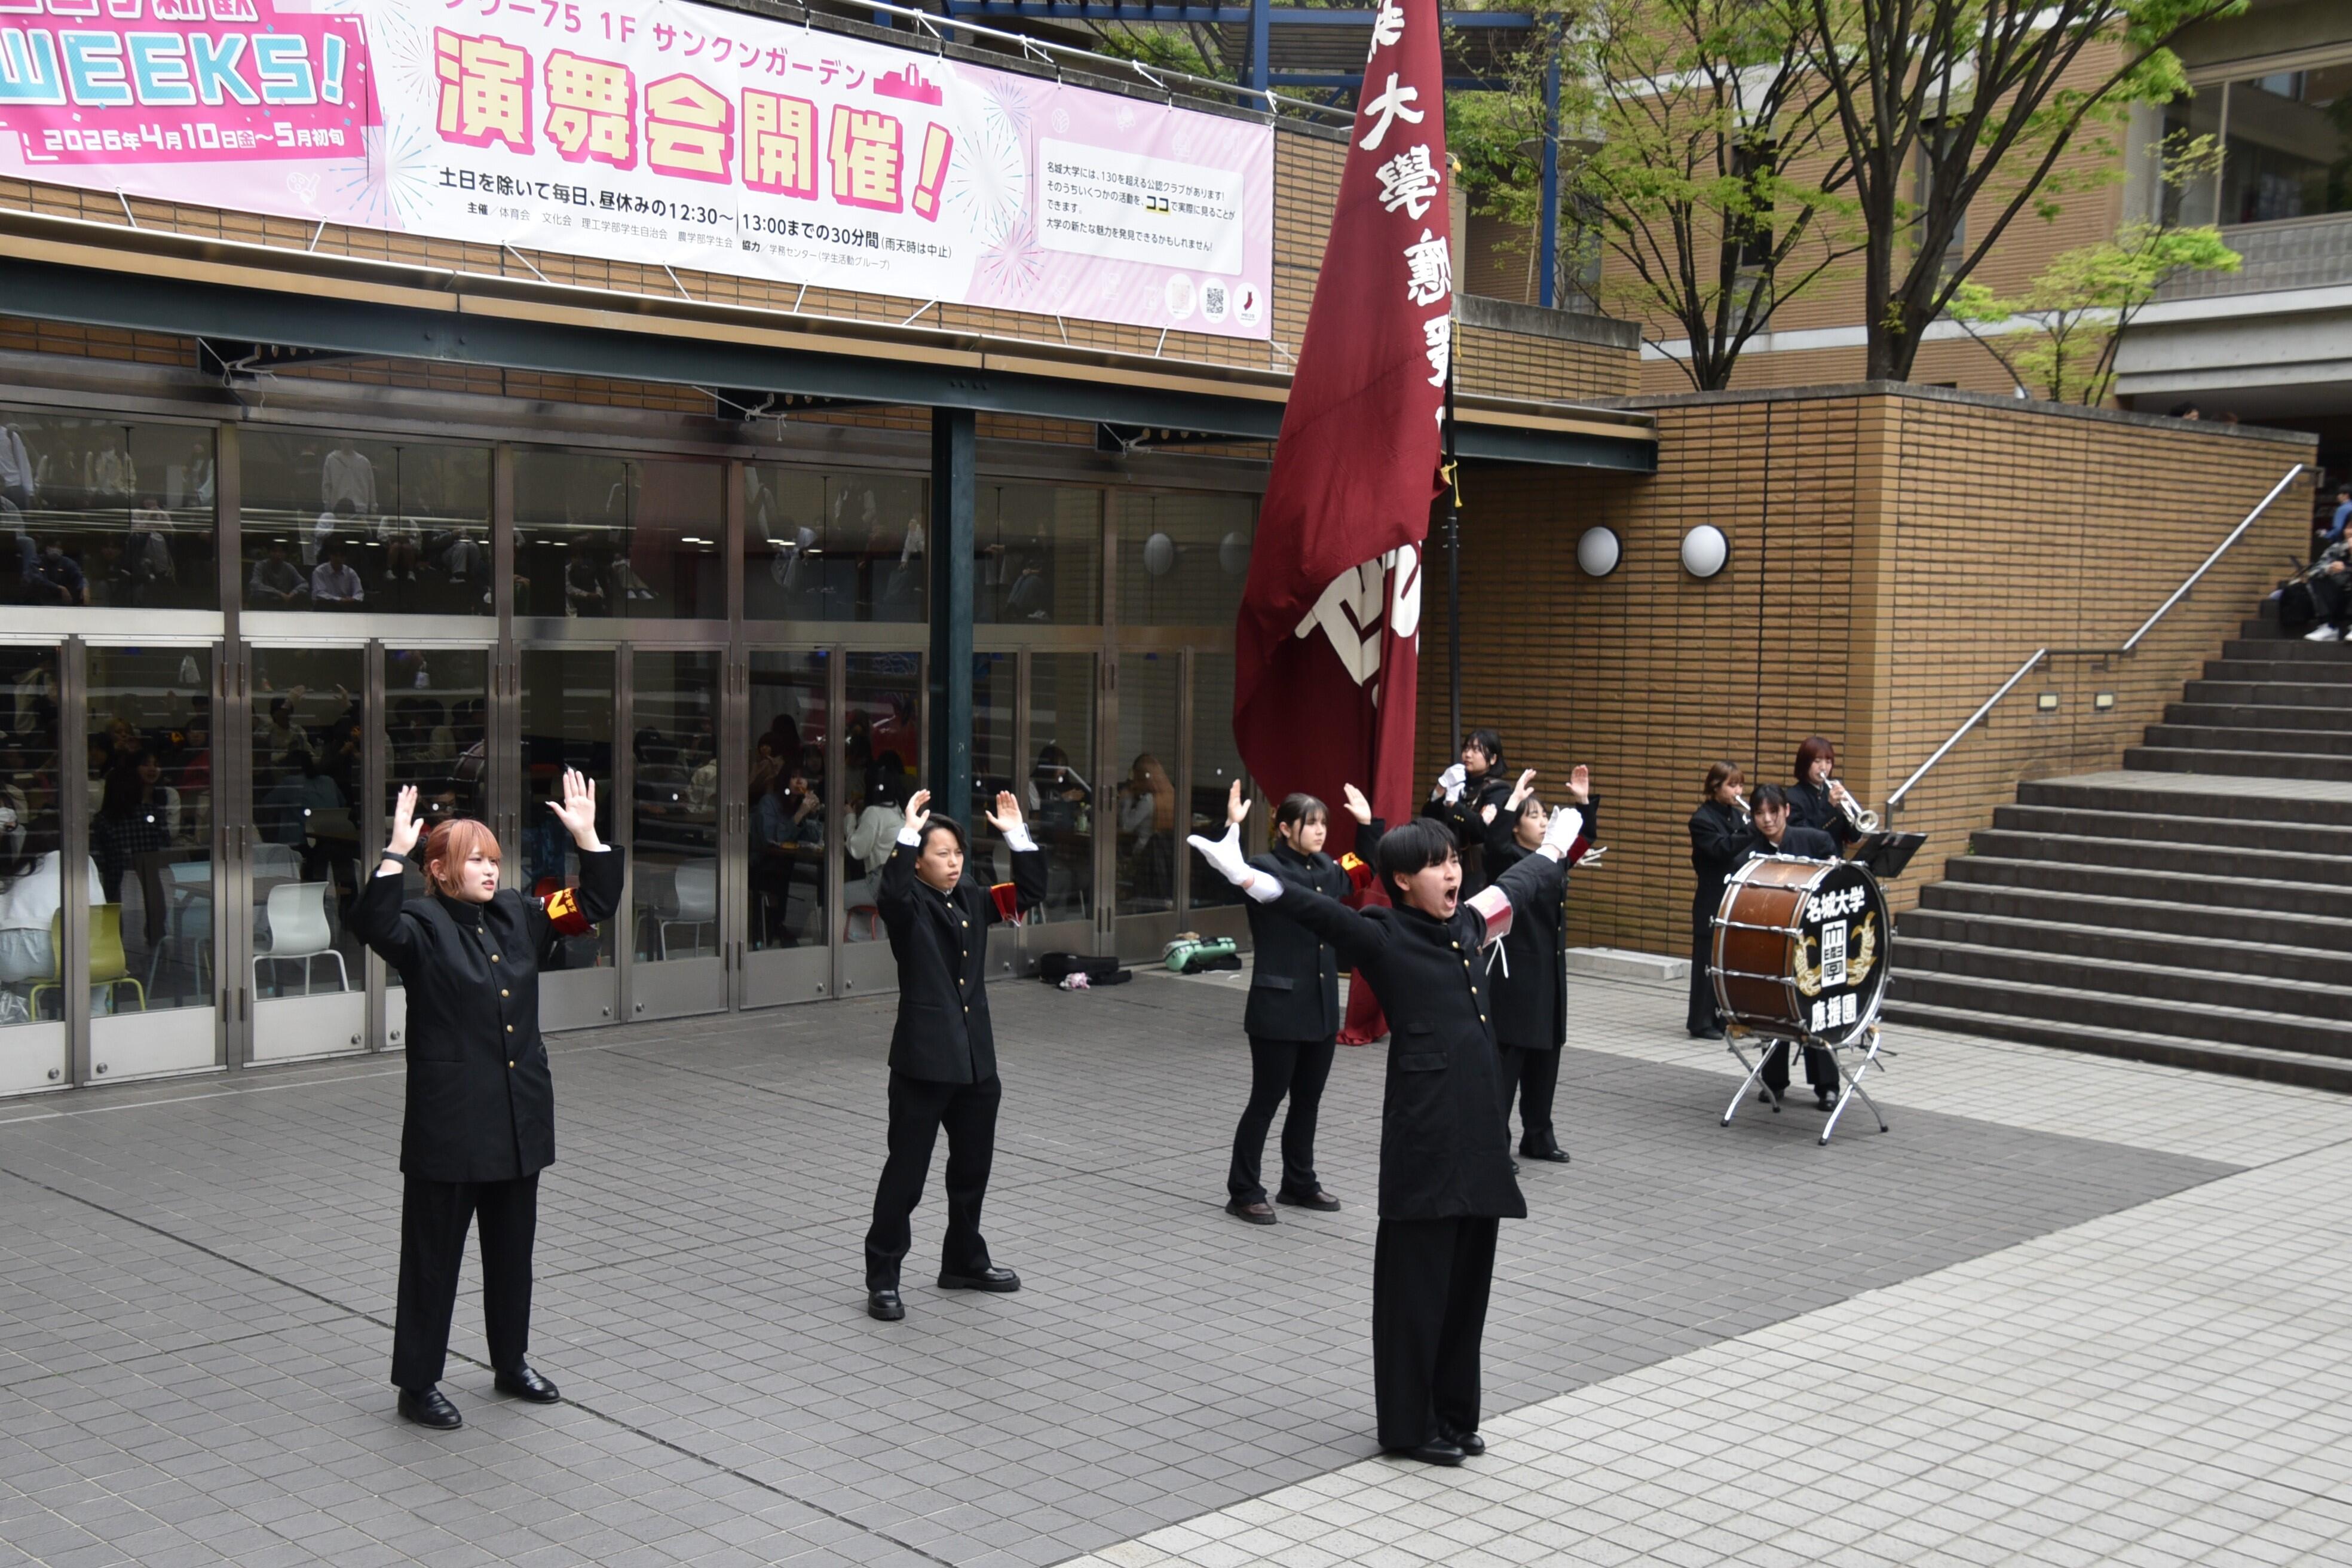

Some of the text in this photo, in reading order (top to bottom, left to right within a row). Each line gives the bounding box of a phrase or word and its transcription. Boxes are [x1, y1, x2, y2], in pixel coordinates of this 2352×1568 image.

[600, 11, 636, 42] 1F
[653, 23, 865, 90] サンクンガーデン
[434, 26, 954, 223] 演舞会開催!
[542, 212, 572, 227] 文化会
[581, 218, 668, 240] 理工学部学生自治会
[1047, 199, 1083, 215] できます。
[1806, 884, 1866, 923] 名城大学
